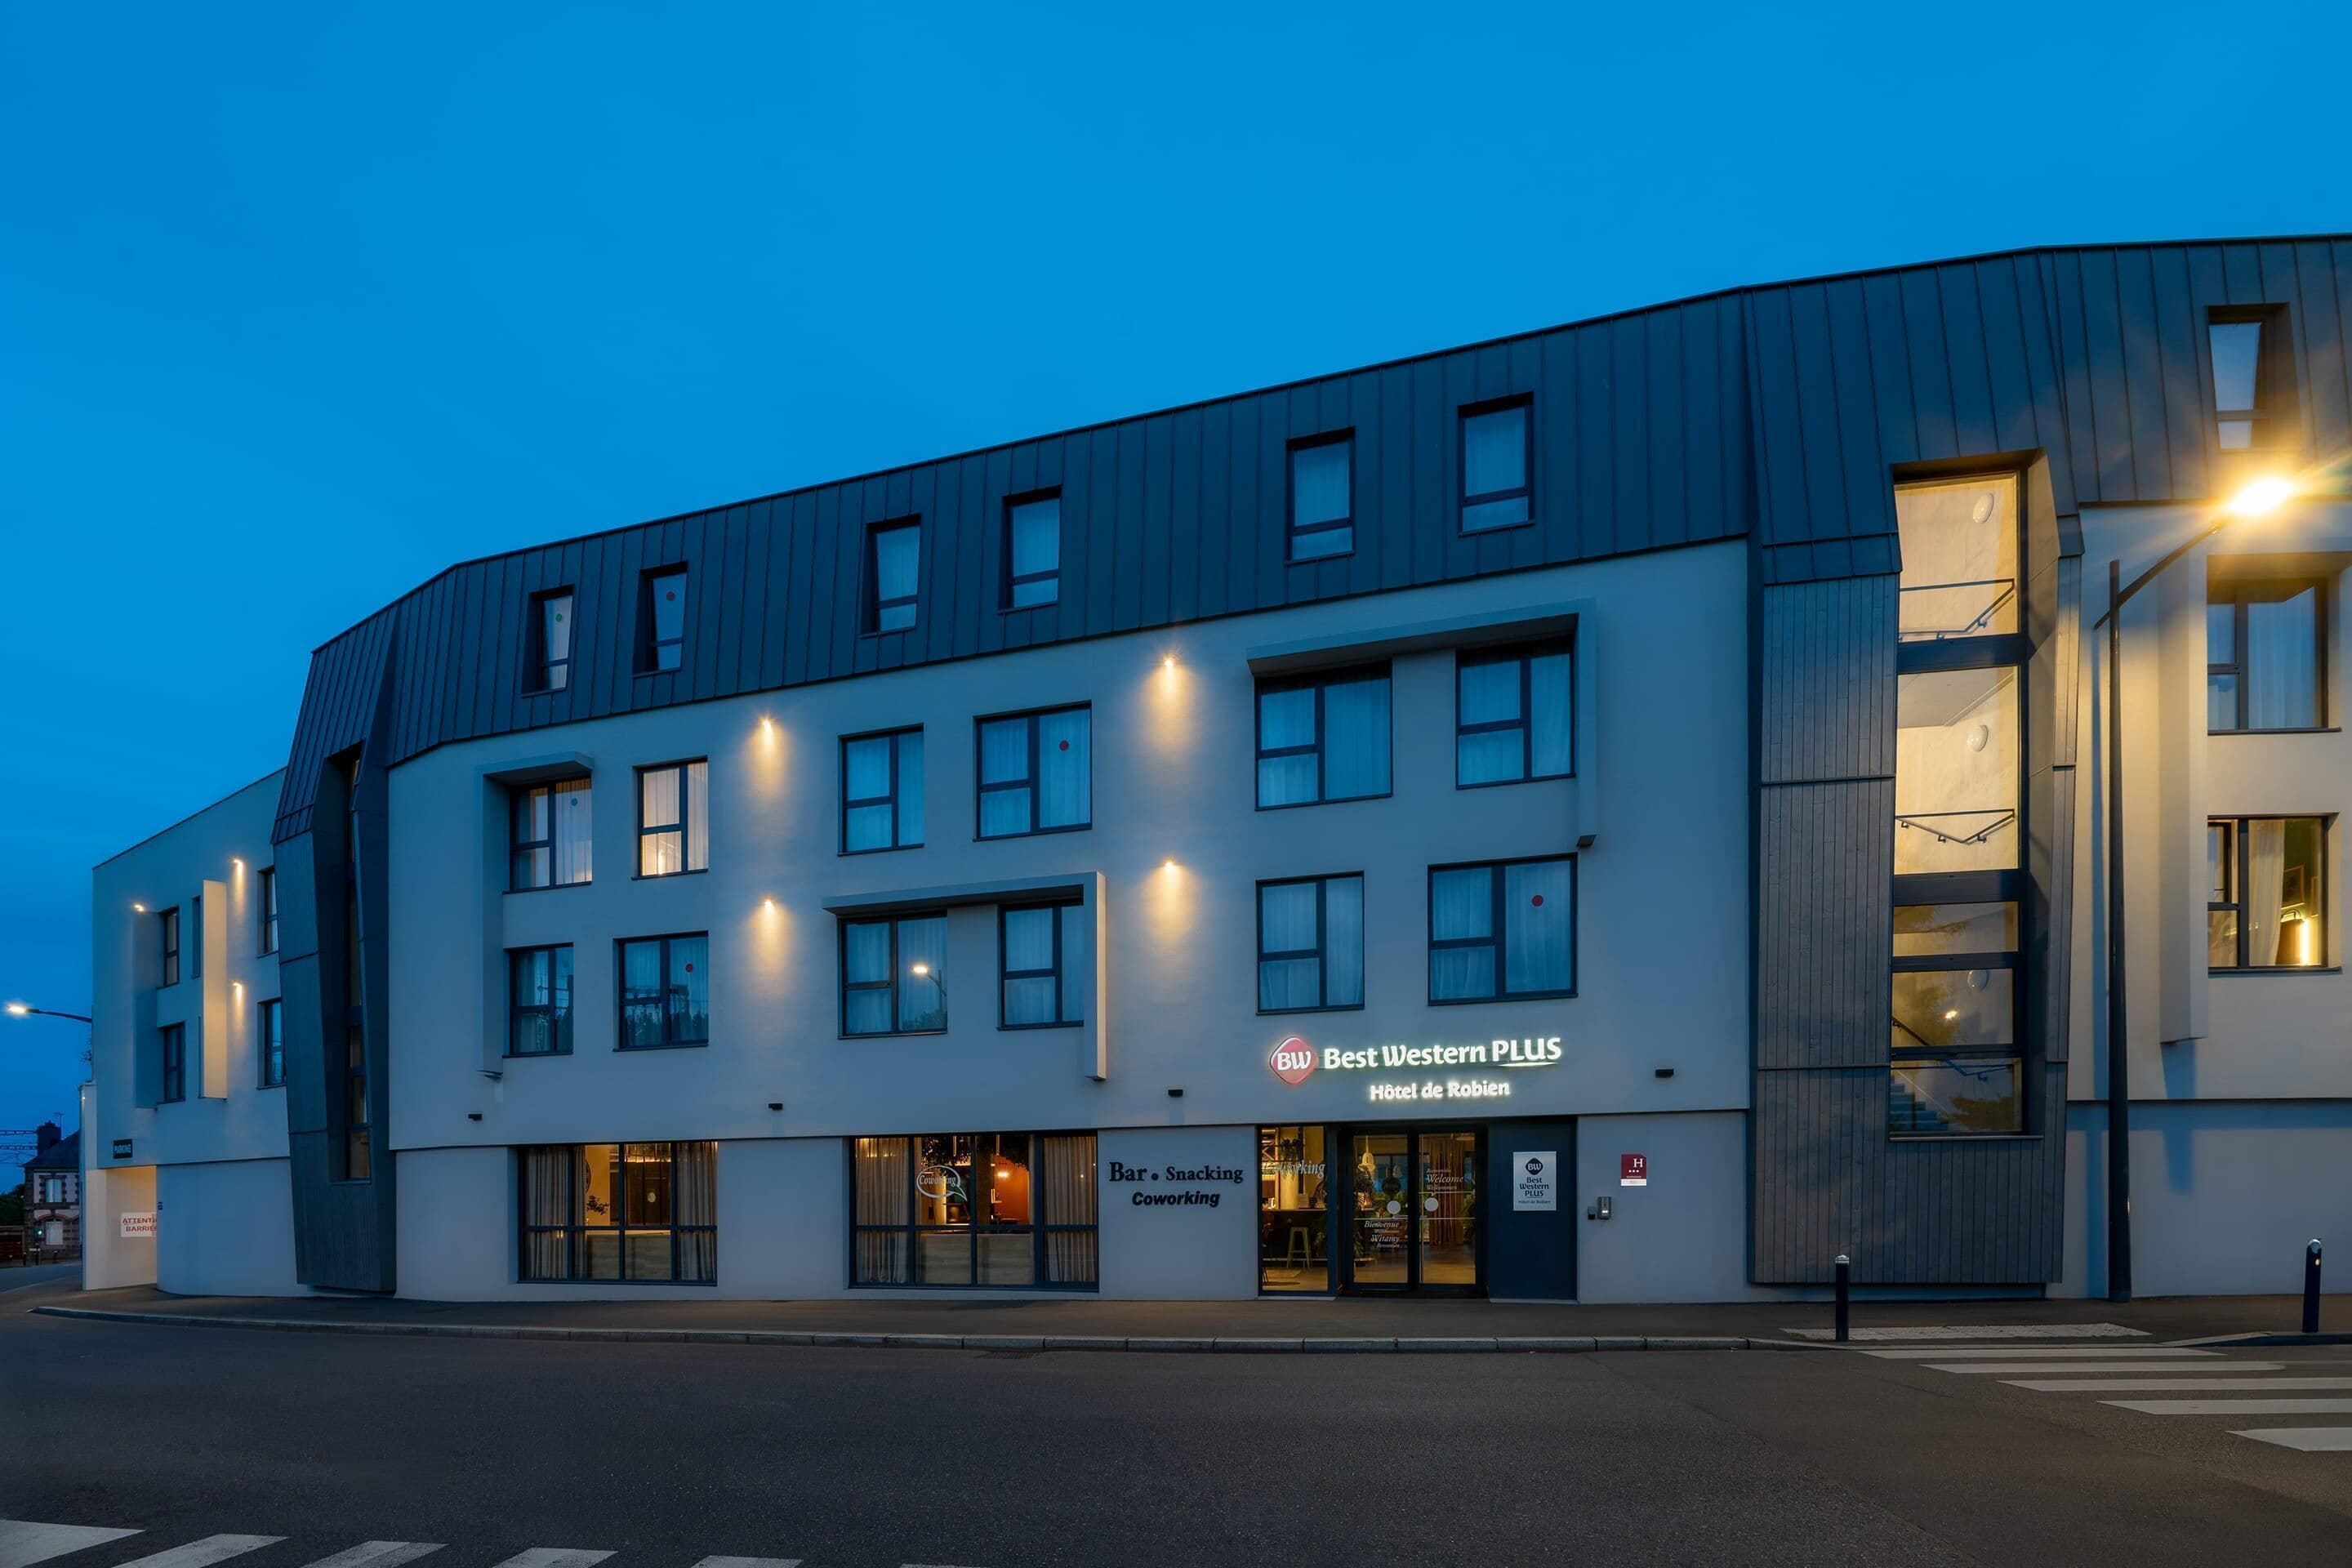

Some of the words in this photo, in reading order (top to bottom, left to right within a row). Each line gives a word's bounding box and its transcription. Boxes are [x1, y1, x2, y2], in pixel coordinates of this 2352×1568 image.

[1277, 1051, 1312, 1071] BW
[1324, 1048, 1379, 1069] Best
[1382, 1045, 1487, 1067] Western
[1491, 1037, 1561, 1062] PLUS
[1370, 1082, 1418, 1100] Hôtel
[1421, 1081, 1444, 1098] de
[1448, 1080, 1511, 1098] Robien
[1109, 1161, 1147, 1182] Bar
[1165, 1165, 1244, 1184] Snacking
[1633, 1158, 1643, 1168] H
[1426, 1173, 1464, 1183] Welcome
[1132, 1191, 1221, 1208] Coworking
